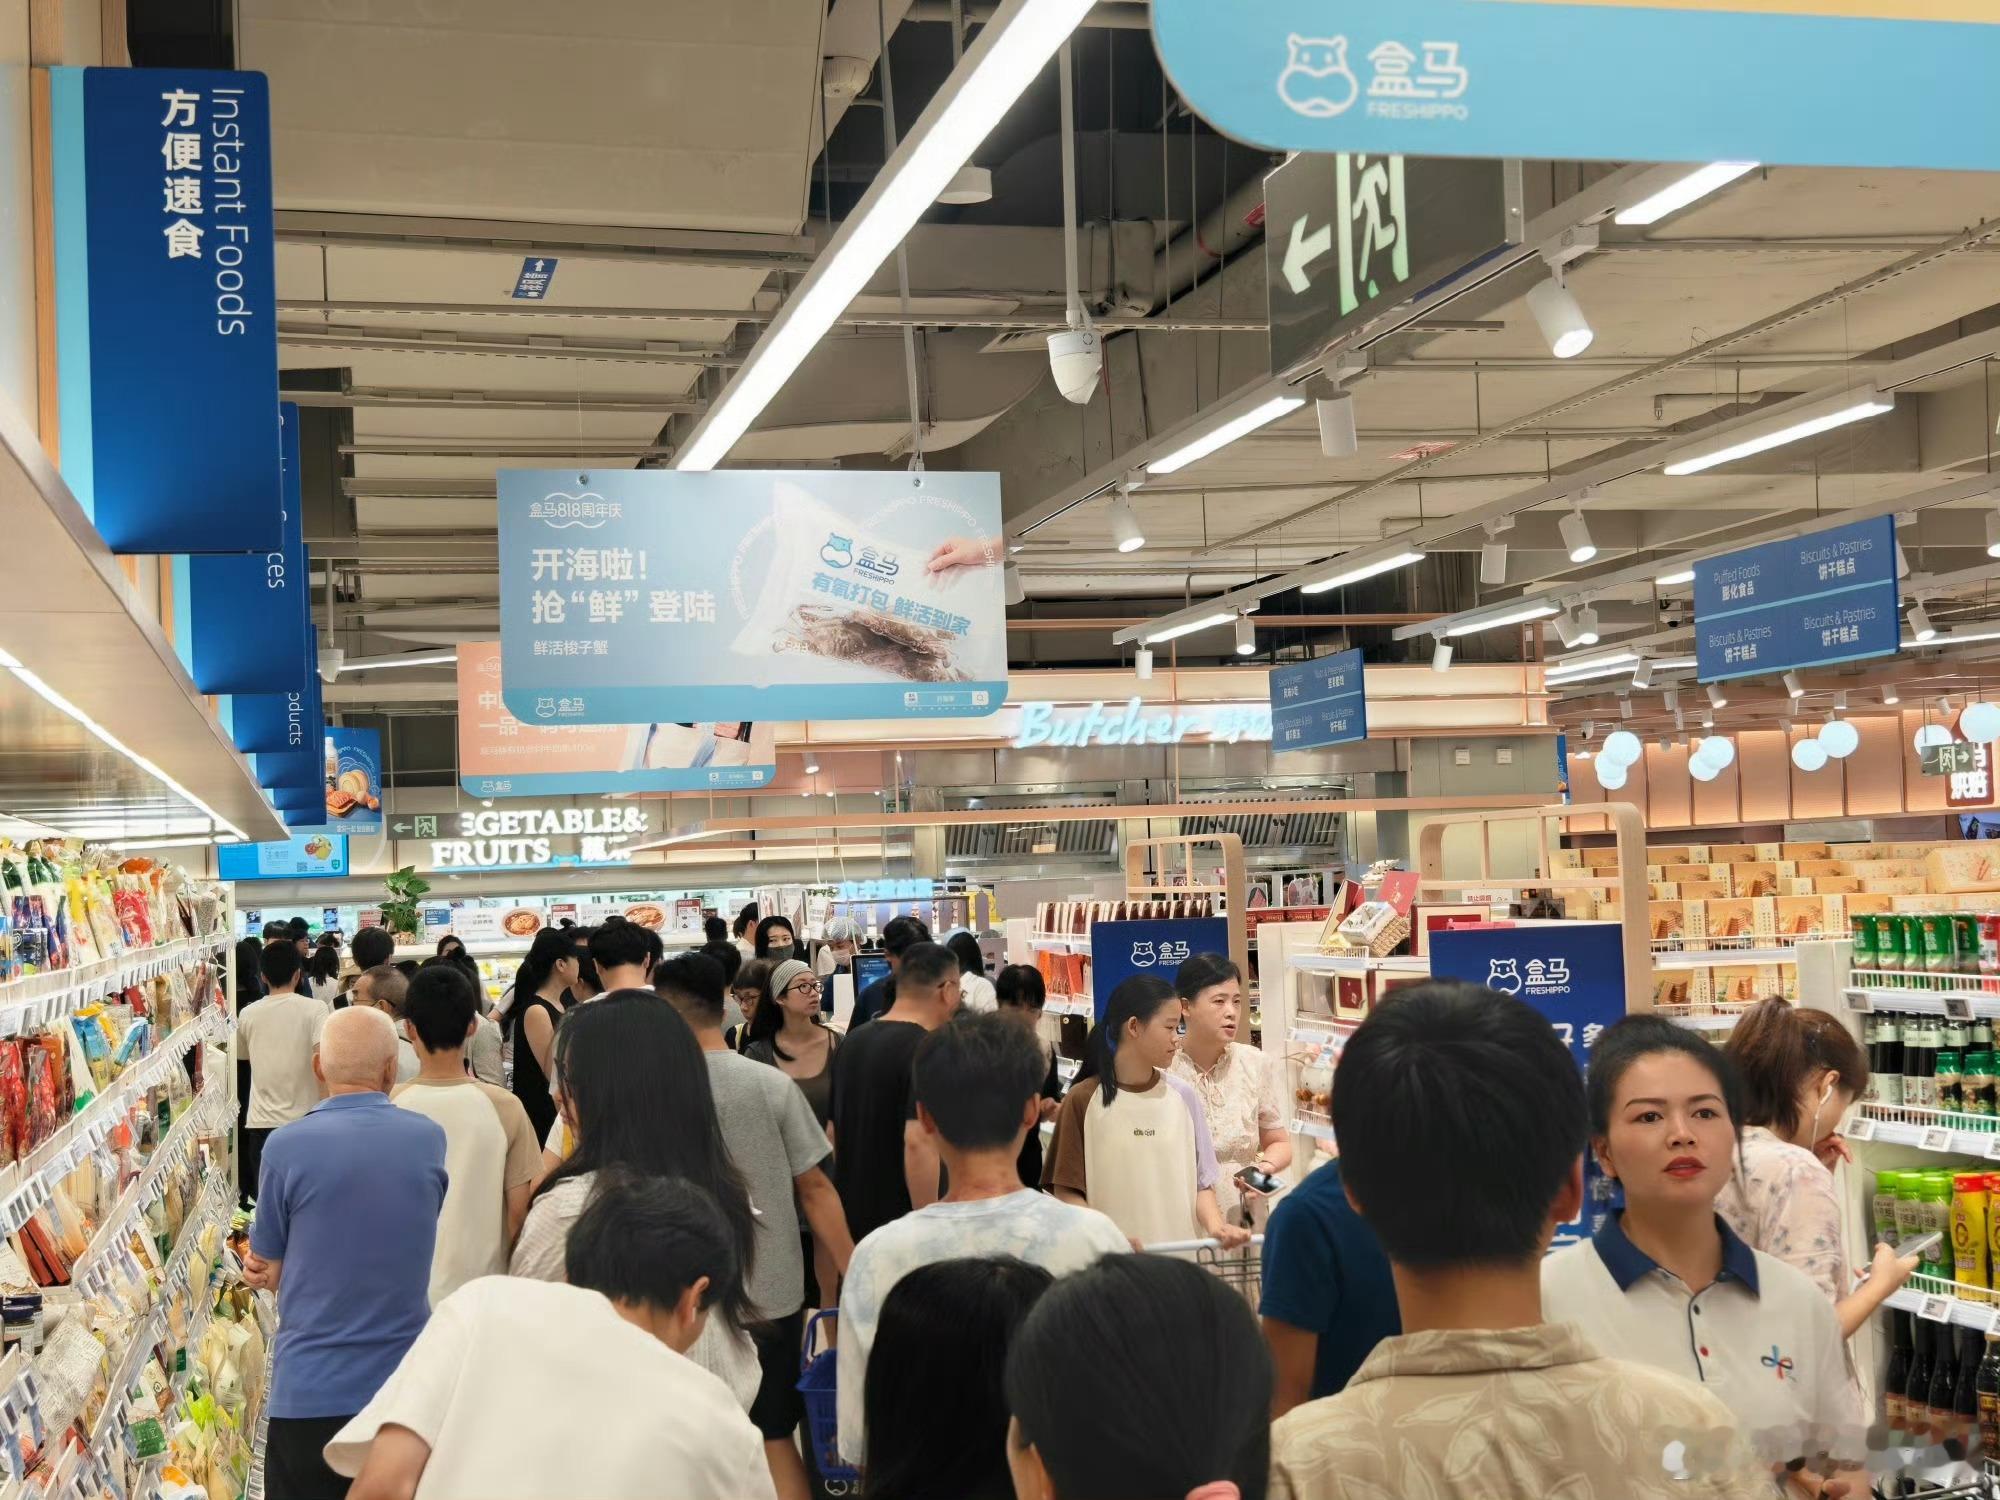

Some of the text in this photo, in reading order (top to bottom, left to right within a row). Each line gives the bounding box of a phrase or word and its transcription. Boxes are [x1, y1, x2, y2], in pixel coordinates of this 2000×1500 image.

[1366, 40, 1469, 98] 盒马
[1366, 102, 1469, 120] FRESHIPPO
[161, 88, 205, 259] 方便速食
[212, 88, 253, 336] Instant Foods
[528, 502, 624, 519] 盒马818周年庆
[855, 545, 900, 576] 盒马
[1800, 538, 1873, 565] Biscuits & Pastries
[853, 567, 895, 586] FRESHIPPO
[1713, 563, 1760, 584] Puffed Foods
[1818, 557, 1856, 581] 饼干糕点
[1721, 581, 1755, 601] 膨化食品
[811, 571, 972, 637] 有氧打包 鲜活到家
[1804, 606, 1876, 630] Biscuits & Pastries
[534, 639, 609, 656] 鲜活梭子蟹
[1709, 625, 1772, 647] Biscuits & Pastries
[1821, 625, 1859, 647] 饼干糕点
[1724, 643, 1757, 663] 饼干糕点
[558, 698, 584, 711] 盒马
[288, 692, 303, 745] oducts
[1013, 696, 1200, 748] Butcher
[460, 806, 648, 837] EGETABLE&
[431, 838, 550, 868] FRUITS
[1158, 941, 1190, 959] 盒马
[1525, 958, 1570, 986] 盒马
[1525, 986, 1571, 995] FRESHIPPO
